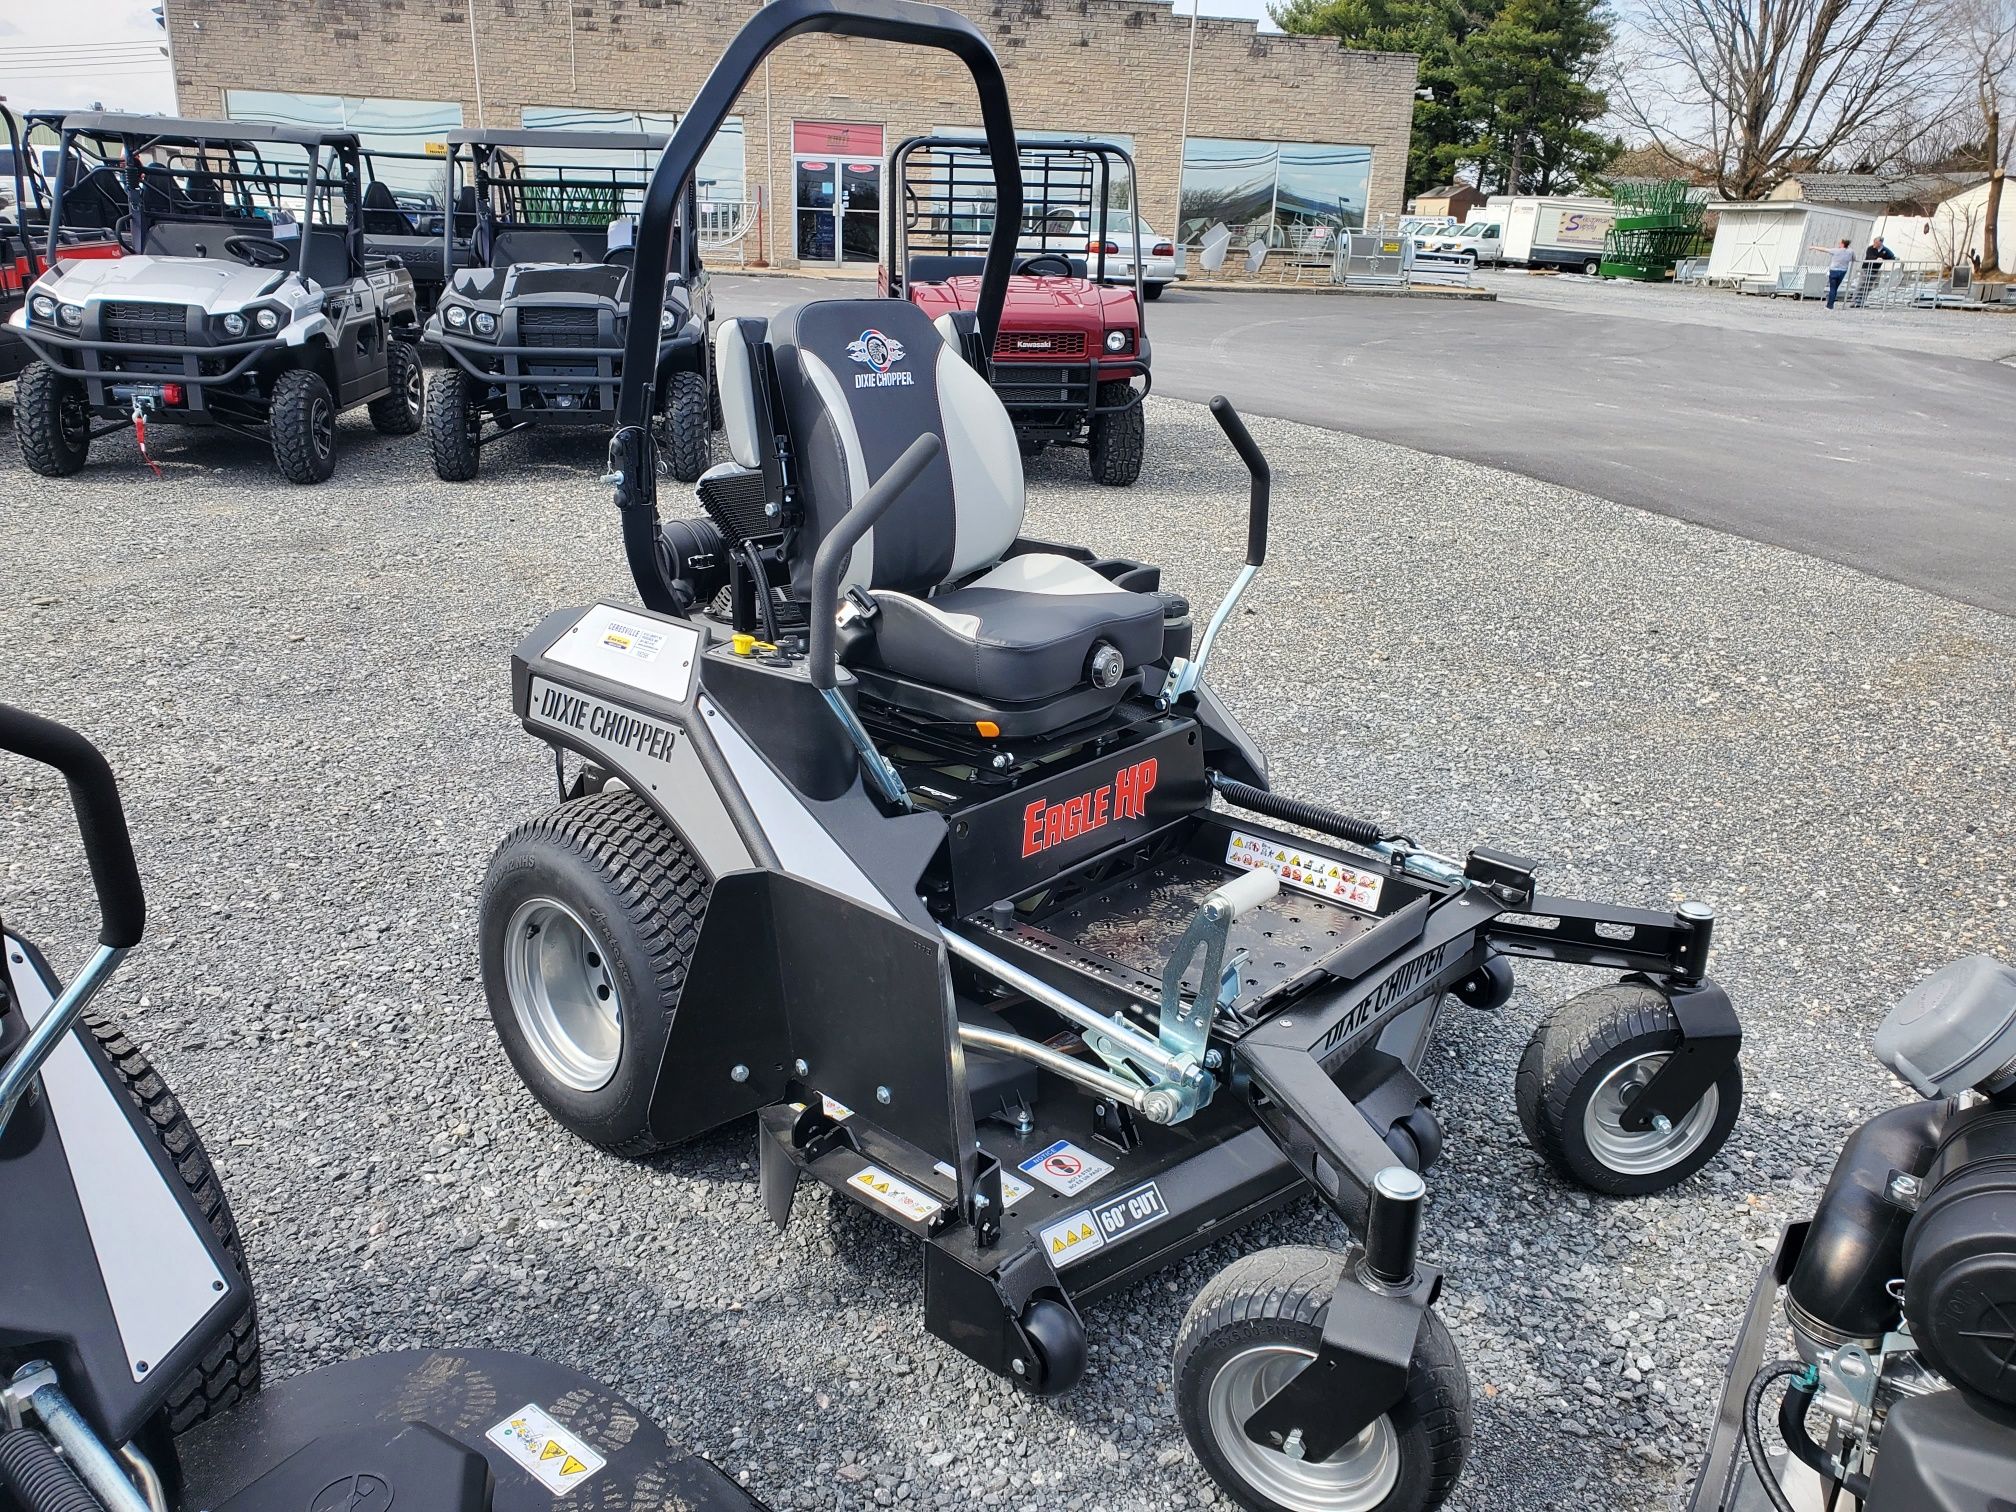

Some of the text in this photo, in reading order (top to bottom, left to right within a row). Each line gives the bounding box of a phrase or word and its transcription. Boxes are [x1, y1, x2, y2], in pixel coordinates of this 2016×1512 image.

[1017, 340, 1051, 348] Kawasaki
[855, 371, 914, 388] DIXIE CHOPPER
[540, 688, 676, 763] DIXIE CHOPPER
[1113, 757, 1158, 821] HP
[1324, 944, 1447, 1050] DIXIE CHOPPER
[1033, 1148, 1056, 1164] NOTICE
[1128, 1190, 1159, 1220] CUT
